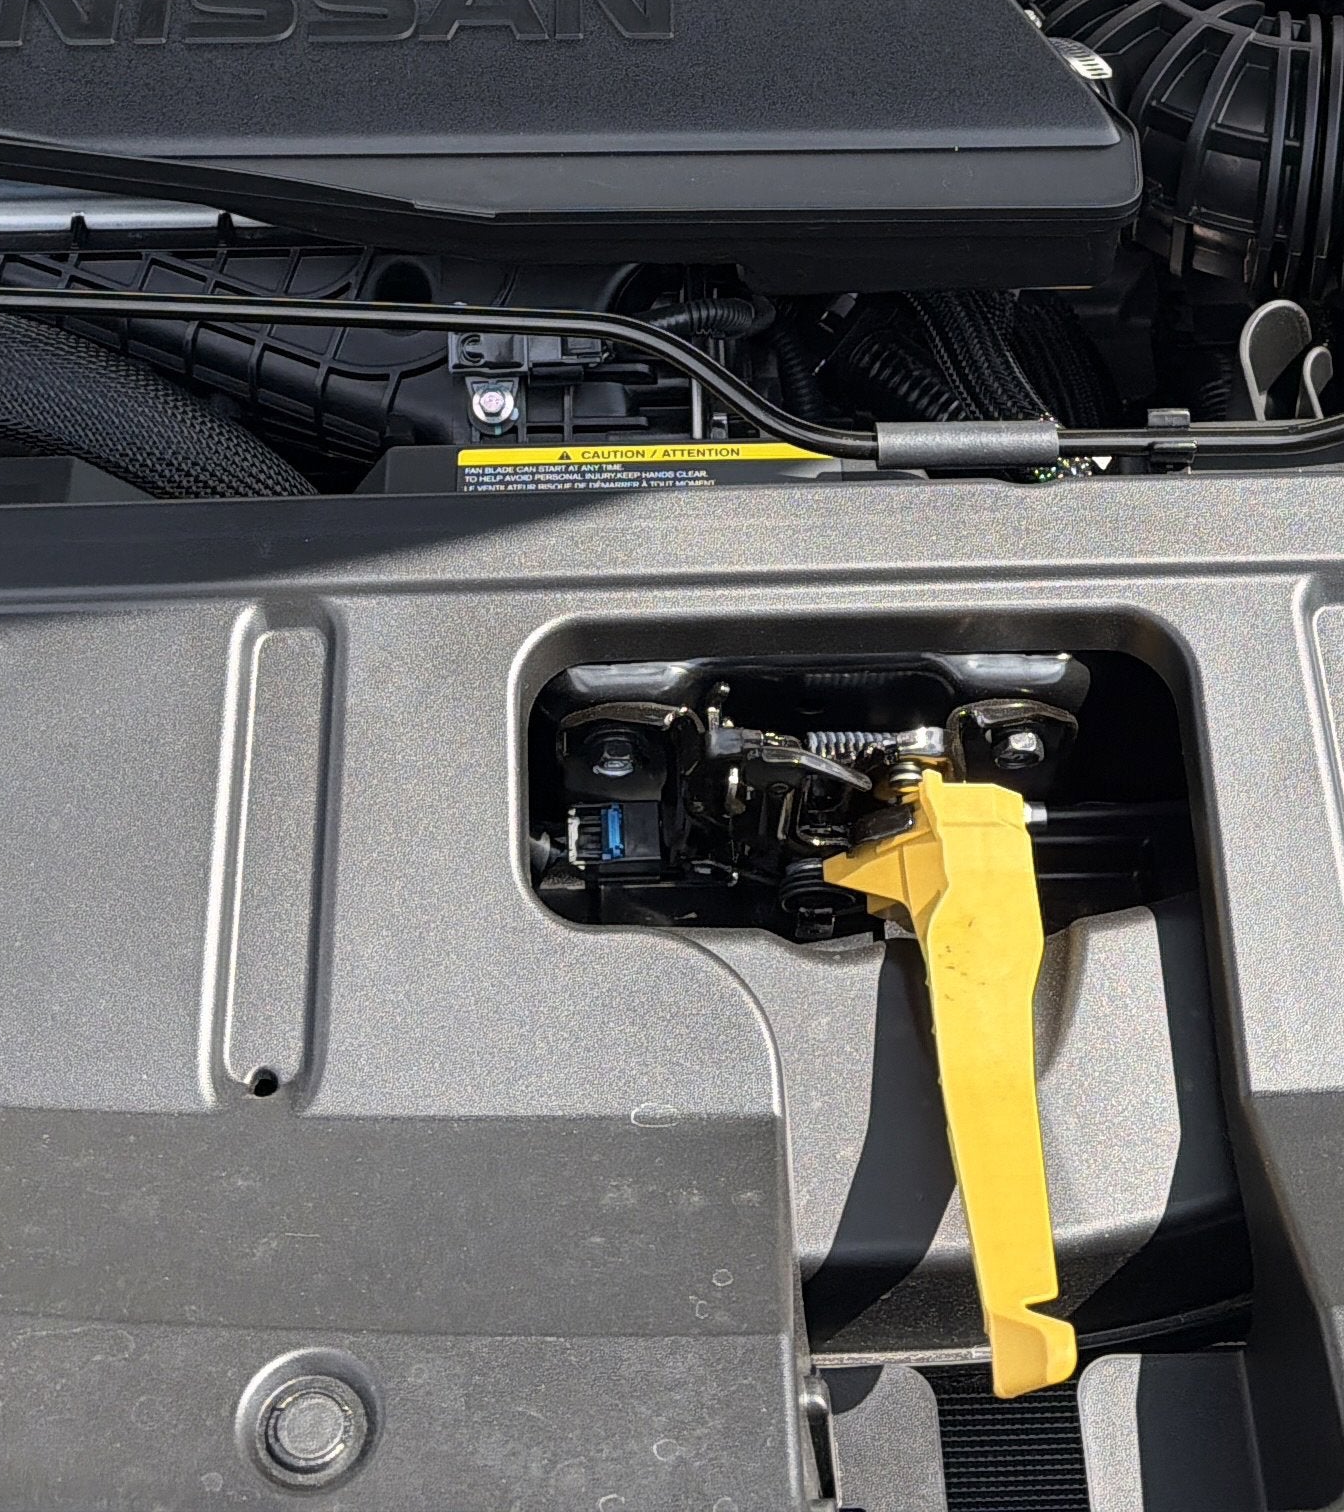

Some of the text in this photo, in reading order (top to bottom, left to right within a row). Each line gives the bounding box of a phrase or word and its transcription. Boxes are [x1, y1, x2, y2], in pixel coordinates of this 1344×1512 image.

[581, 449, 646, 460] CAUTION
[661, 447, 740, 459] ATTENTION
[464, 466, 483, 475] FAN
[484, 466, 515, 474] BLADE
[516, 465, 537, 473] CAN
[538, 464, 567, 473] START
[567, 464, 581, 472] AT
[581, 463, 601, 472] ANY
[464, 475, 478, 483] TO
[479, 474, 504, 483] HELP
[504, 474, 533, 482] AVOID
[534, 472, 583, 481] PERSONAL
[642, 470, 675, 479] HANDS
